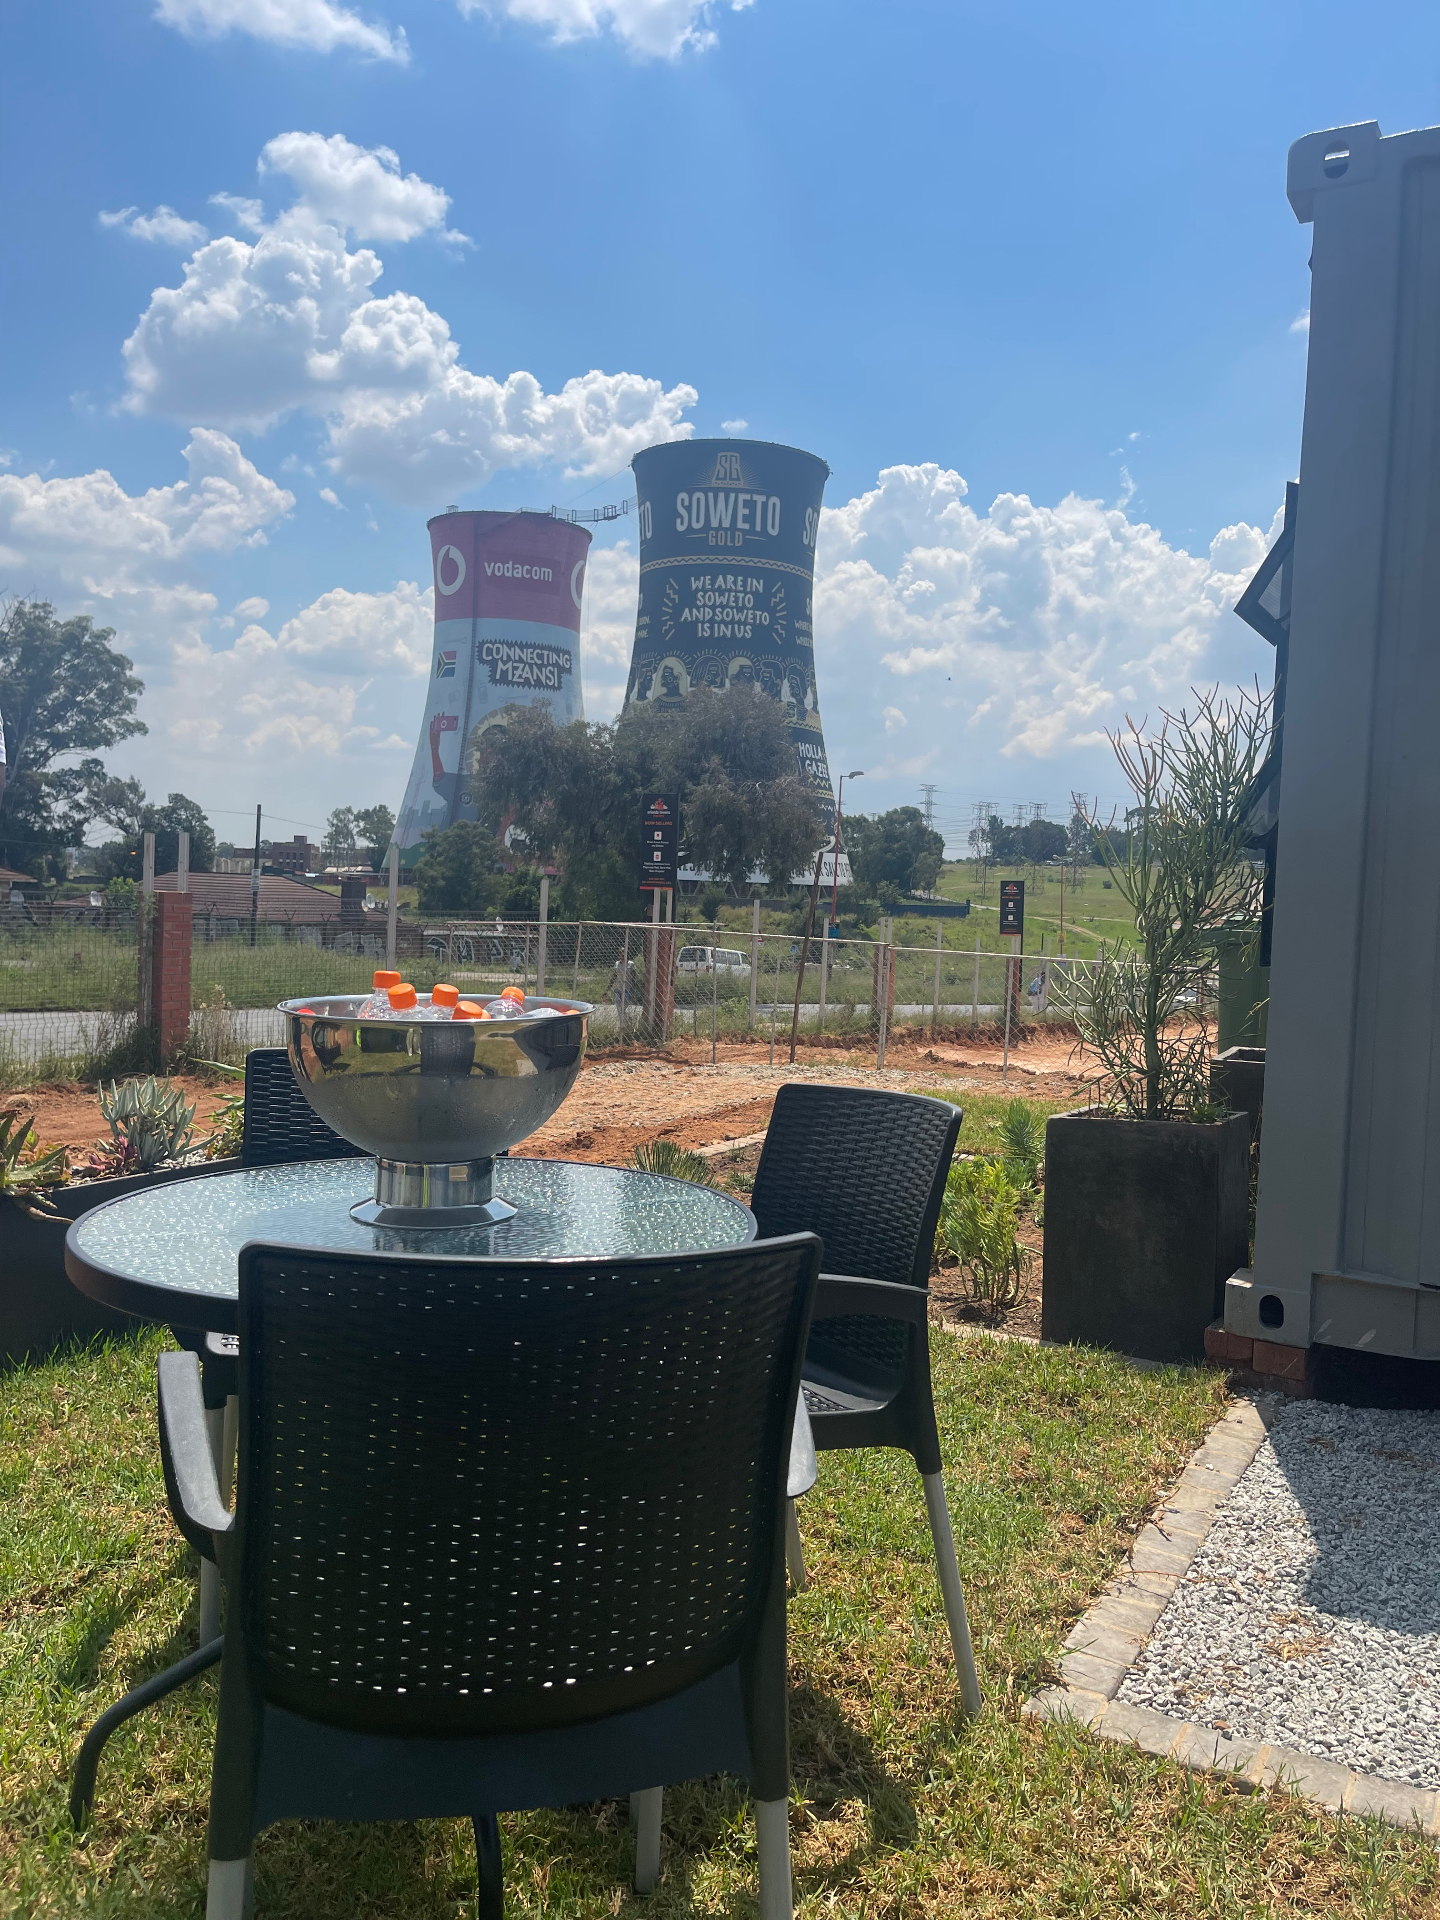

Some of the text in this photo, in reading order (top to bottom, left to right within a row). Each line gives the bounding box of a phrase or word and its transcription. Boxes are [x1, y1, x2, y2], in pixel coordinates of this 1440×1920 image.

[639, 501, 653, 541] TO
[675, 492, 781, 536] SOWETO
[708, 530, 743, 546] GOLD
[484, 560, 553, 582] vodacom
[690, 574, 764, 593] WE ARE IN
[696, 591, 754, 608] SOWETO
[681, 607, 770, 626] AND SOWETO
[698, 622, 752, 639] IS IN US
[482, 643, 571, 669] CONNECTING
[495, 659, 559, 687] MZANSI
